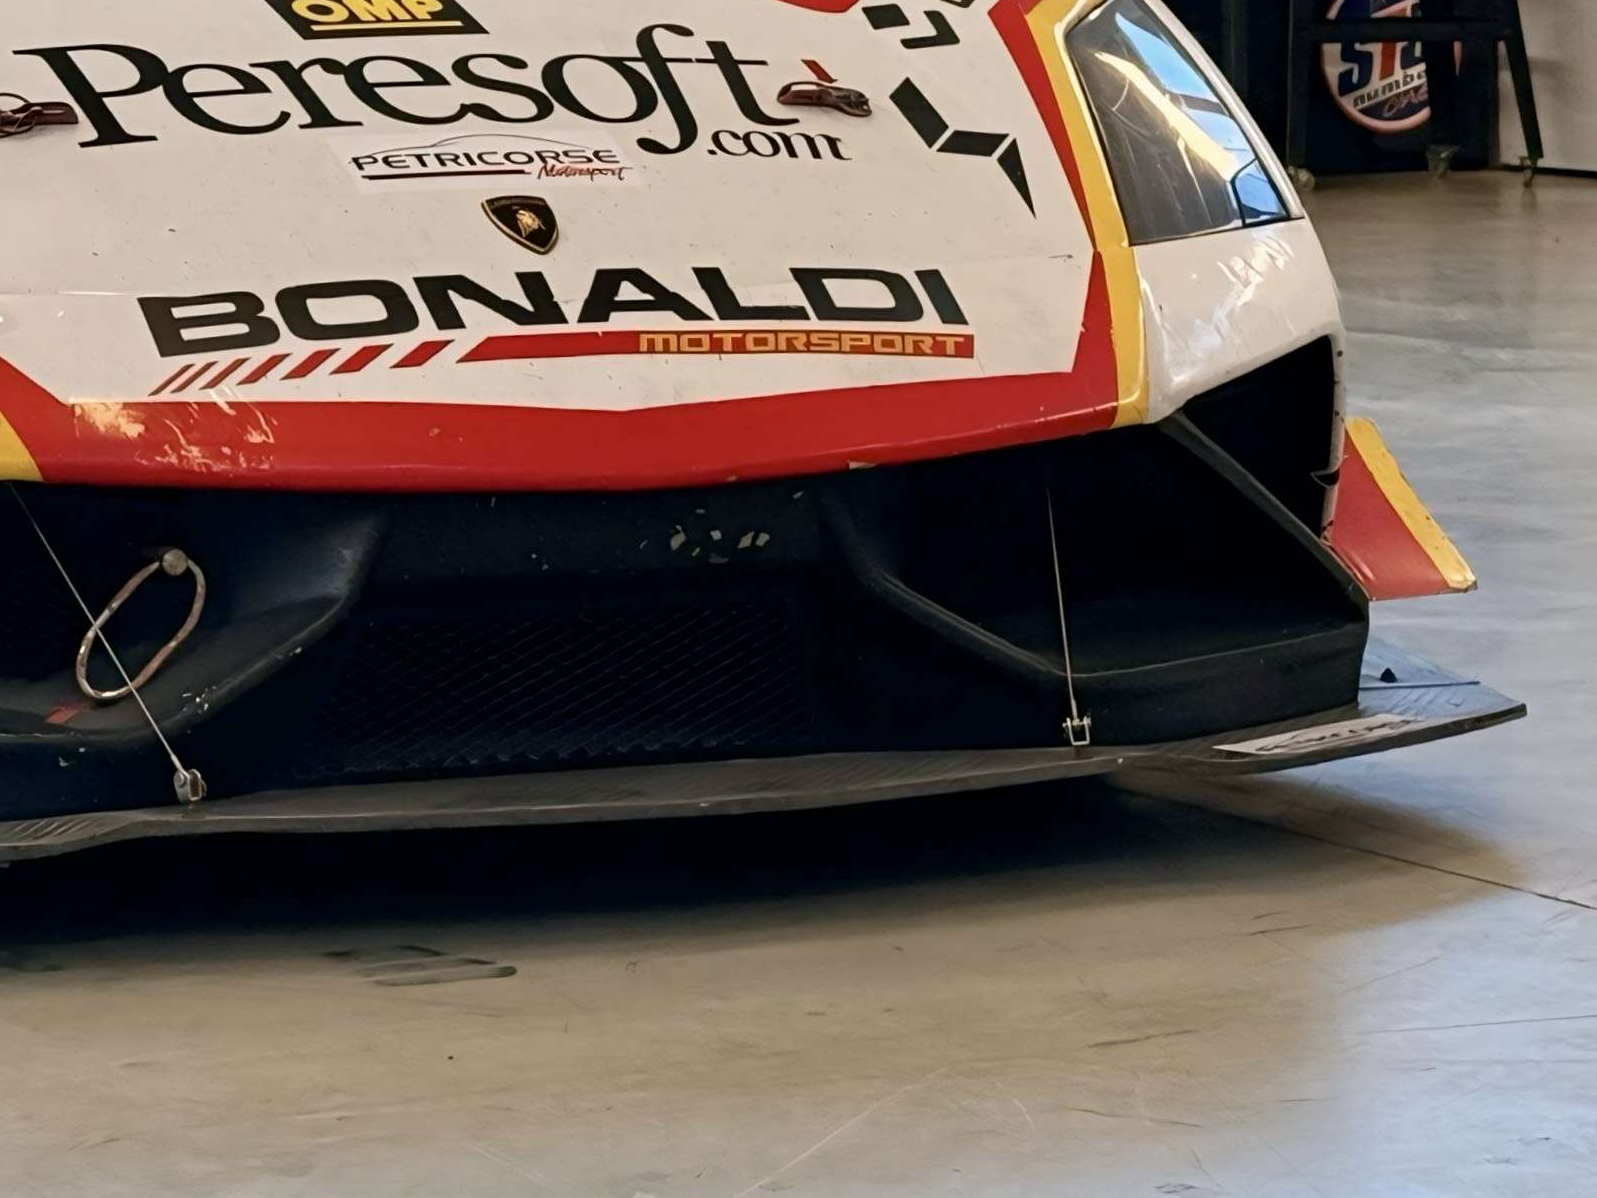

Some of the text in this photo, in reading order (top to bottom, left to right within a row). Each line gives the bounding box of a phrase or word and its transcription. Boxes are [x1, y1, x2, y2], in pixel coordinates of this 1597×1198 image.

[12, 23, 801, 156] Peresoft
[351, 149, 621, 171] PETRICORSE
[137, 266, 971, 360] BONALDI
[638, 332, 966, 358] MOTORSPORT
